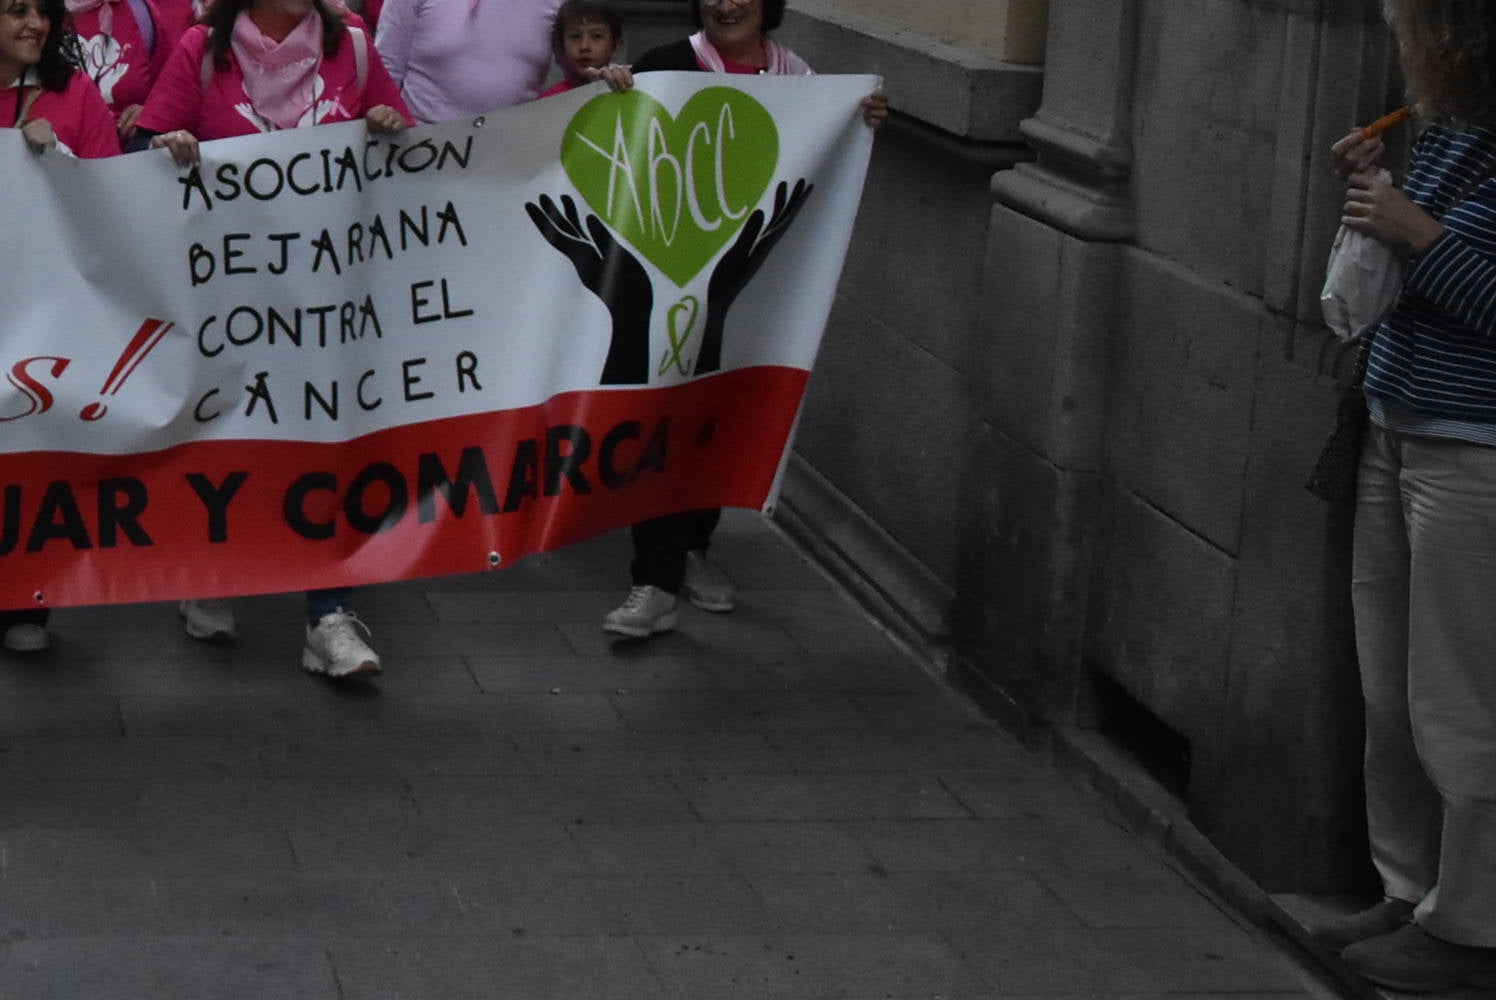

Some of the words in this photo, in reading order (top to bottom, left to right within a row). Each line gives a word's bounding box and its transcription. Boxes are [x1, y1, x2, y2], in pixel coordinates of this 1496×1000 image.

[178, 134, 474, 211] ASOCIACIÓN
[188, 201, 468, 286] BEJARANA
[198, 293, 382, 358] CONTRA
[411, 278, 474, 324] EL
[185, 469, 251, 544] Y
[283, 414, 670, 540] COMARCA
